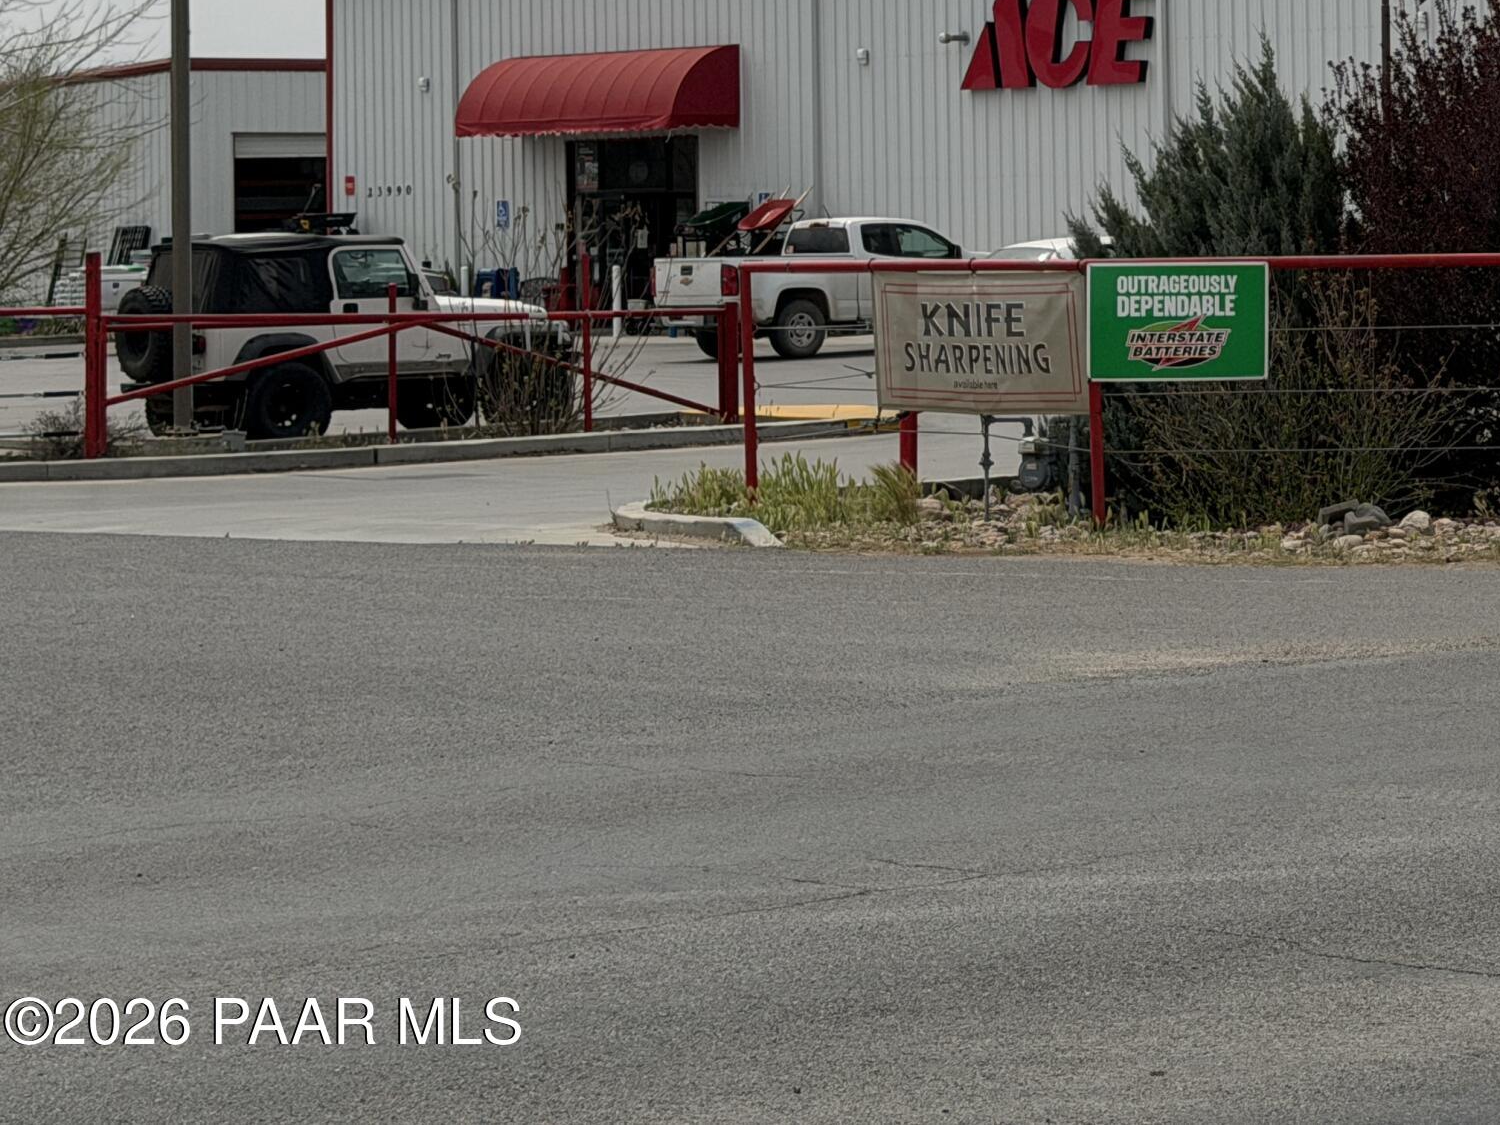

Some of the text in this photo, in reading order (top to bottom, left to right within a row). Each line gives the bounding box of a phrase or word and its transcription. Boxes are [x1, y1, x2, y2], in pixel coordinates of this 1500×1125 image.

[1116, 275, 1238, 294] OUTRAGEOUSLY
[1116, 295, 1237, 318] DEPENDABLE
[921, 302, 1026, 338] KNIFE
[1129, 331, 1226, 344] INTERSTATE
[904, 342, 1052, 375] SHARPENING
[1132, 345, 1219, 357] BATTERIES
